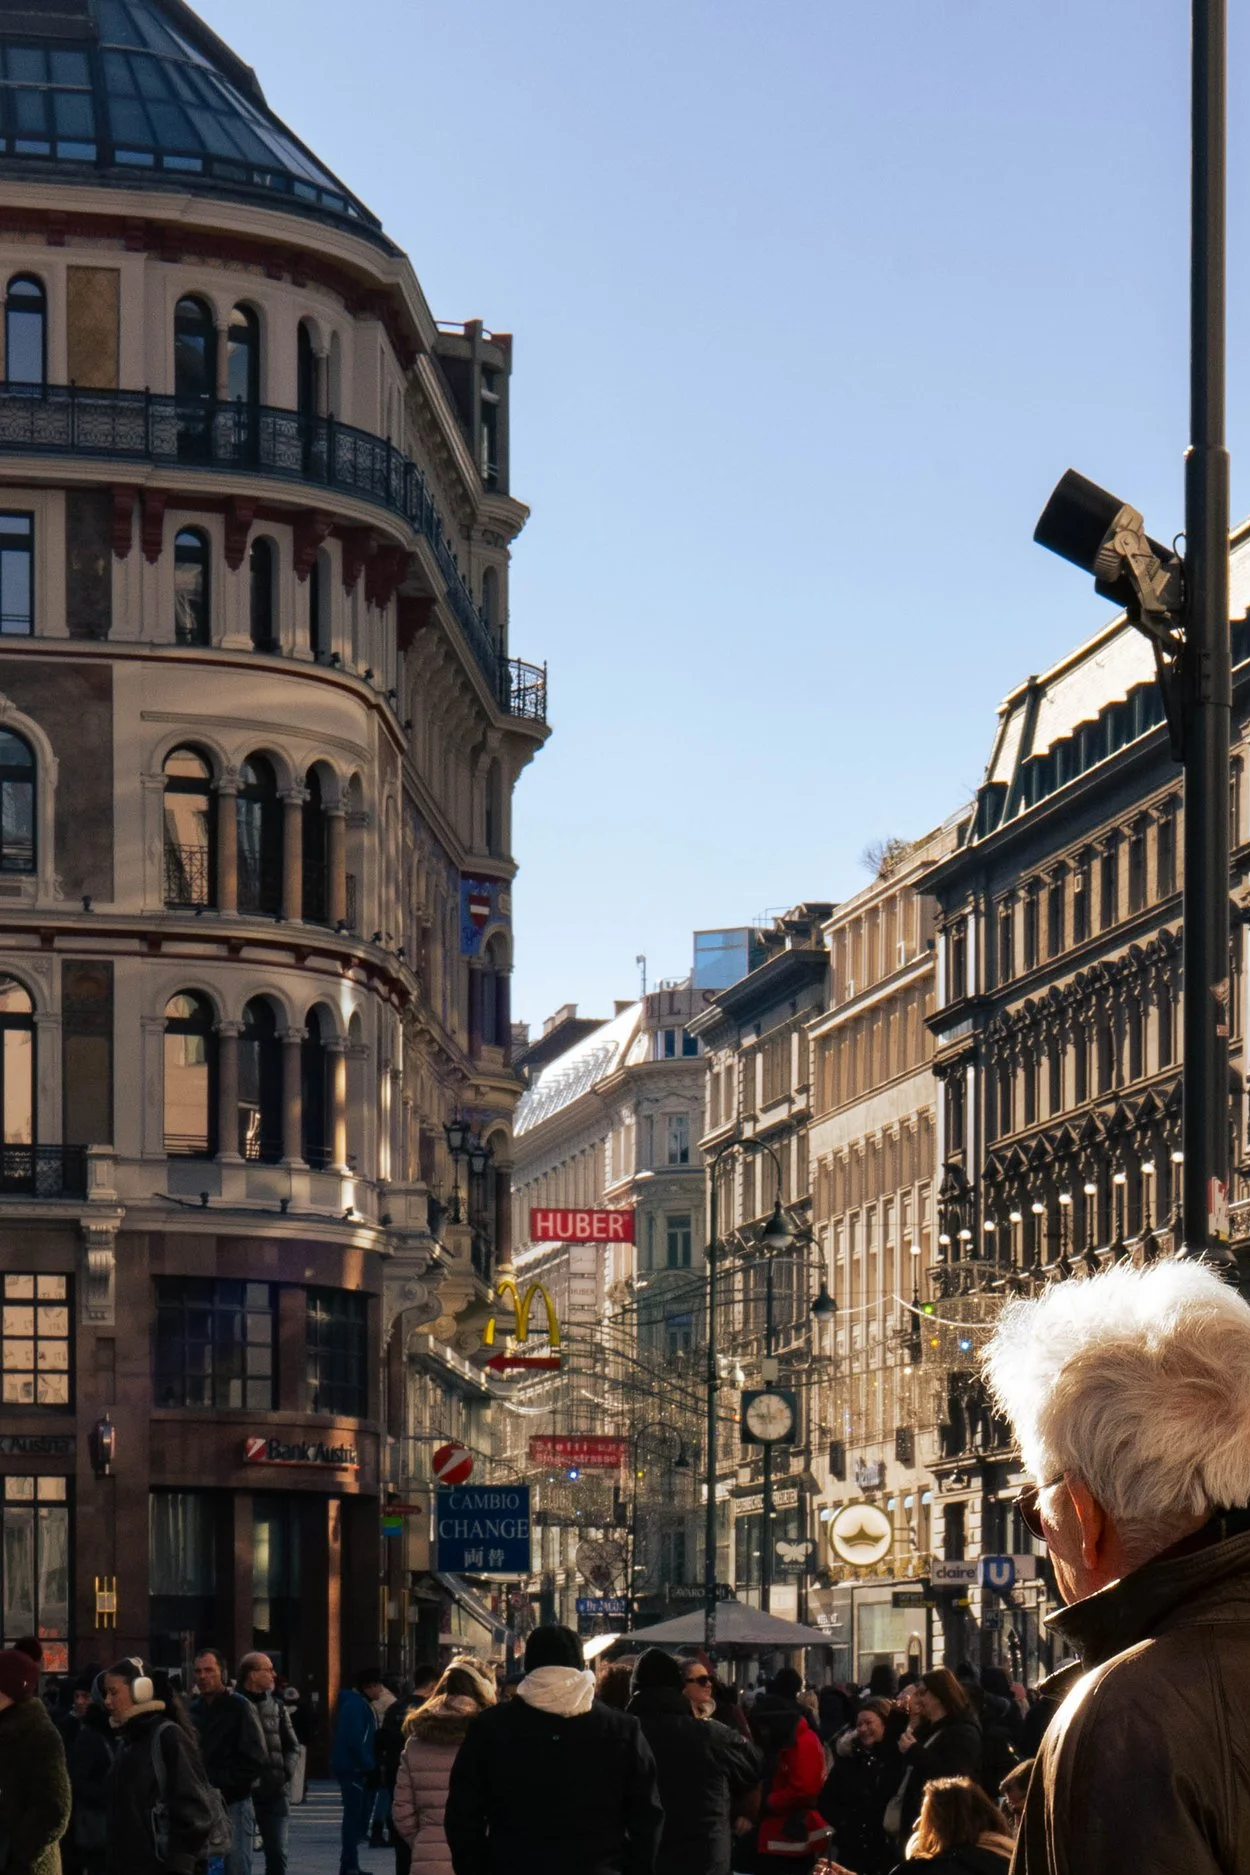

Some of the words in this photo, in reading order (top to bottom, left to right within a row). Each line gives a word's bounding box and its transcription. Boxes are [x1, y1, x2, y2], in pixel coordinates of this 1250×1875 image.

[536, 1213, 624, 1237] HUBER
[268, 1437, 307, 1461] Bank
[450, 1493, 520, 1509] CAMBIO
[439, 1519, 529, 1539] CHANGE
[989, 1563, 1011, 1585] U
